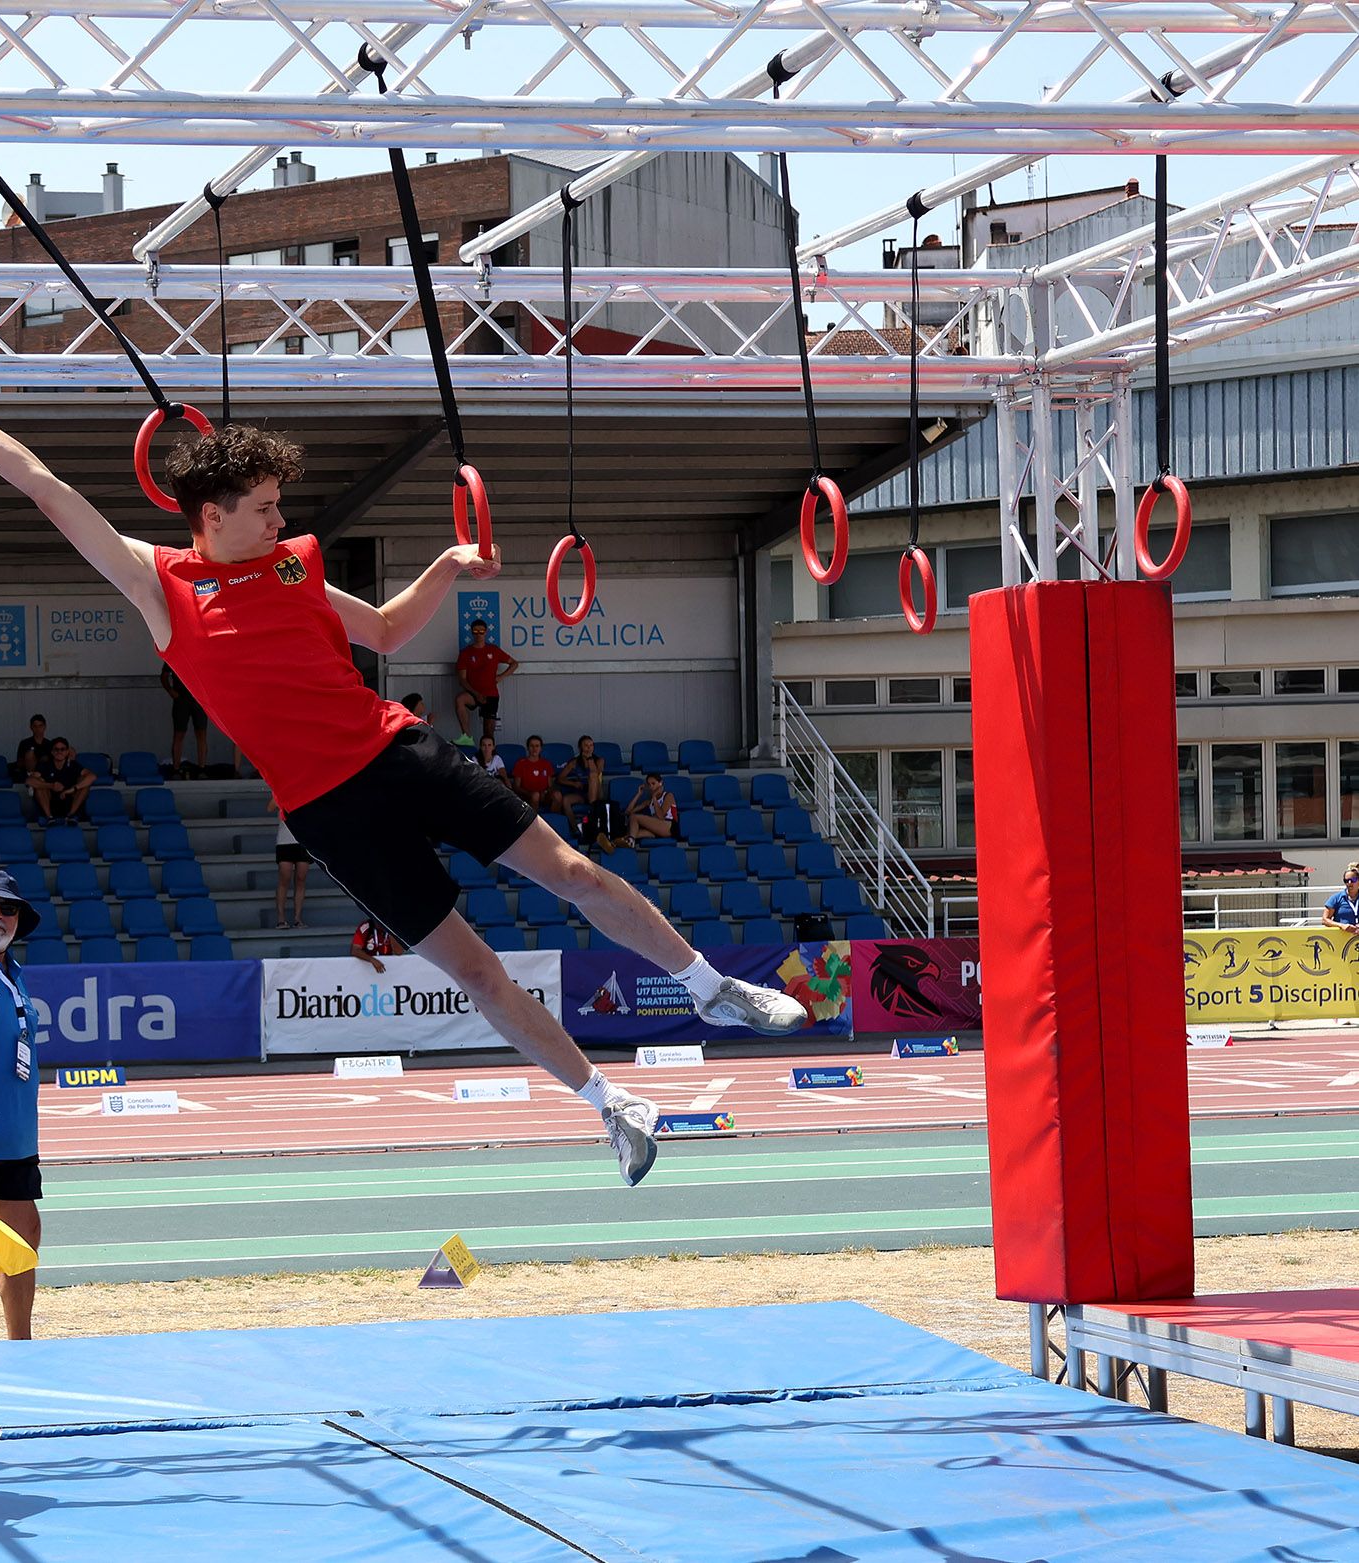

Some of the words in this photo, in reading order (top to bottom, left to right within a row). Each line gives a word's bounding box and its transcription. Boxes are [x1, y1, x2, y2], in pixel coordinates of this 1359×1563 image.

[228, 574, 254, 585] CRAFT
[51, 610, 124, 624] DEPORTE
[51, 628, 118, 642] GALEGO
[511, 625, 544, 647] DE
[555, 624, 665, 646] GALICIA
[636, 987, 650, 995] U17
[1185, 986, 1242, 1011] Sport
[1249, 984, 1264, 1003] 5
[636, 1007, 692, 1016] PONTEVEDRA,
[65, 1069, 118, 1085] UIPM
